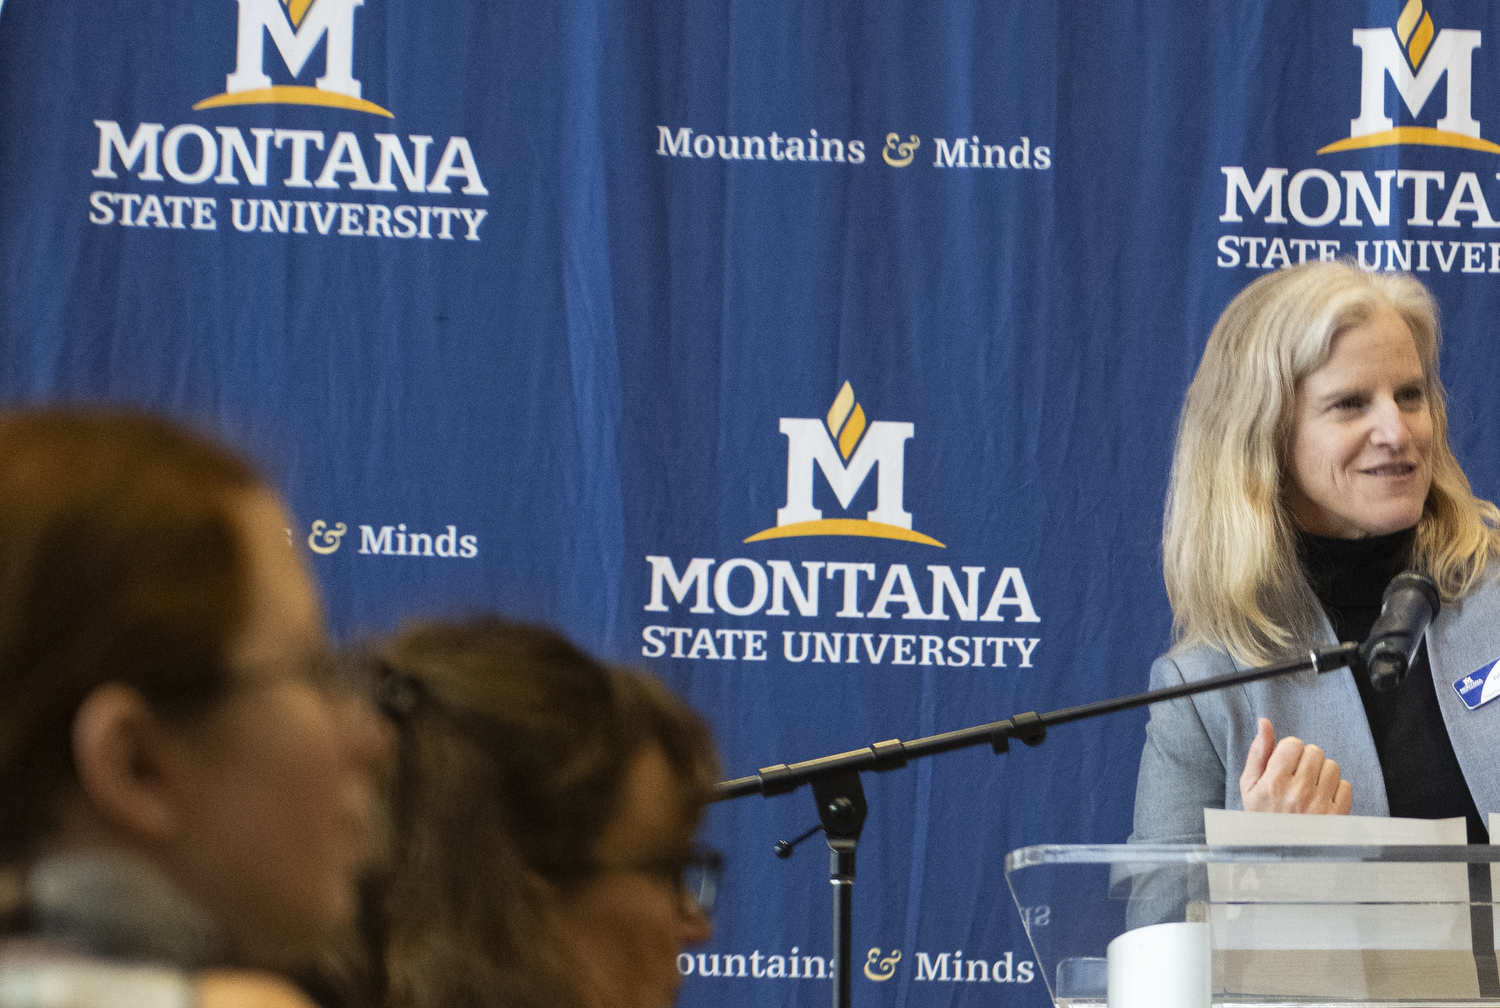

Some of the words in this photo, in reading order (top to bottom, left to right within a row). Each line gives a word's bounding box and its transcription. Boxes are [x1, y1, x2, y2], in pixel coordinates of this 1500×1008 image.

[226, 0, 364, 98] M
[1349, 28, 1482, 139] M
[91, 120, 489, 197] MONTANA
[658, 126, 865, 163] Mountains
[882, 133, 920, 167] &
[935, 136, 1050, 169] Minds
[90, 192, 216, 230] STATE
[231, 199, 487, 240] UNIVERSITY
[1216, 235, 1341, 269] STATE
[777, 417, 915, 531] M
[308, 520, 346, 554] &
[359, 524, 477, 558] Minds
[645, 556, 1040, 622] MONTANA
[642, 626, 767, 660] STATE
[783, 631, 1039, 667] UNIVERSITY
[675, 946, 834, 979] ountain
[864, 948, 901, 981] &
[916, 951, 1034, 983] Minds
